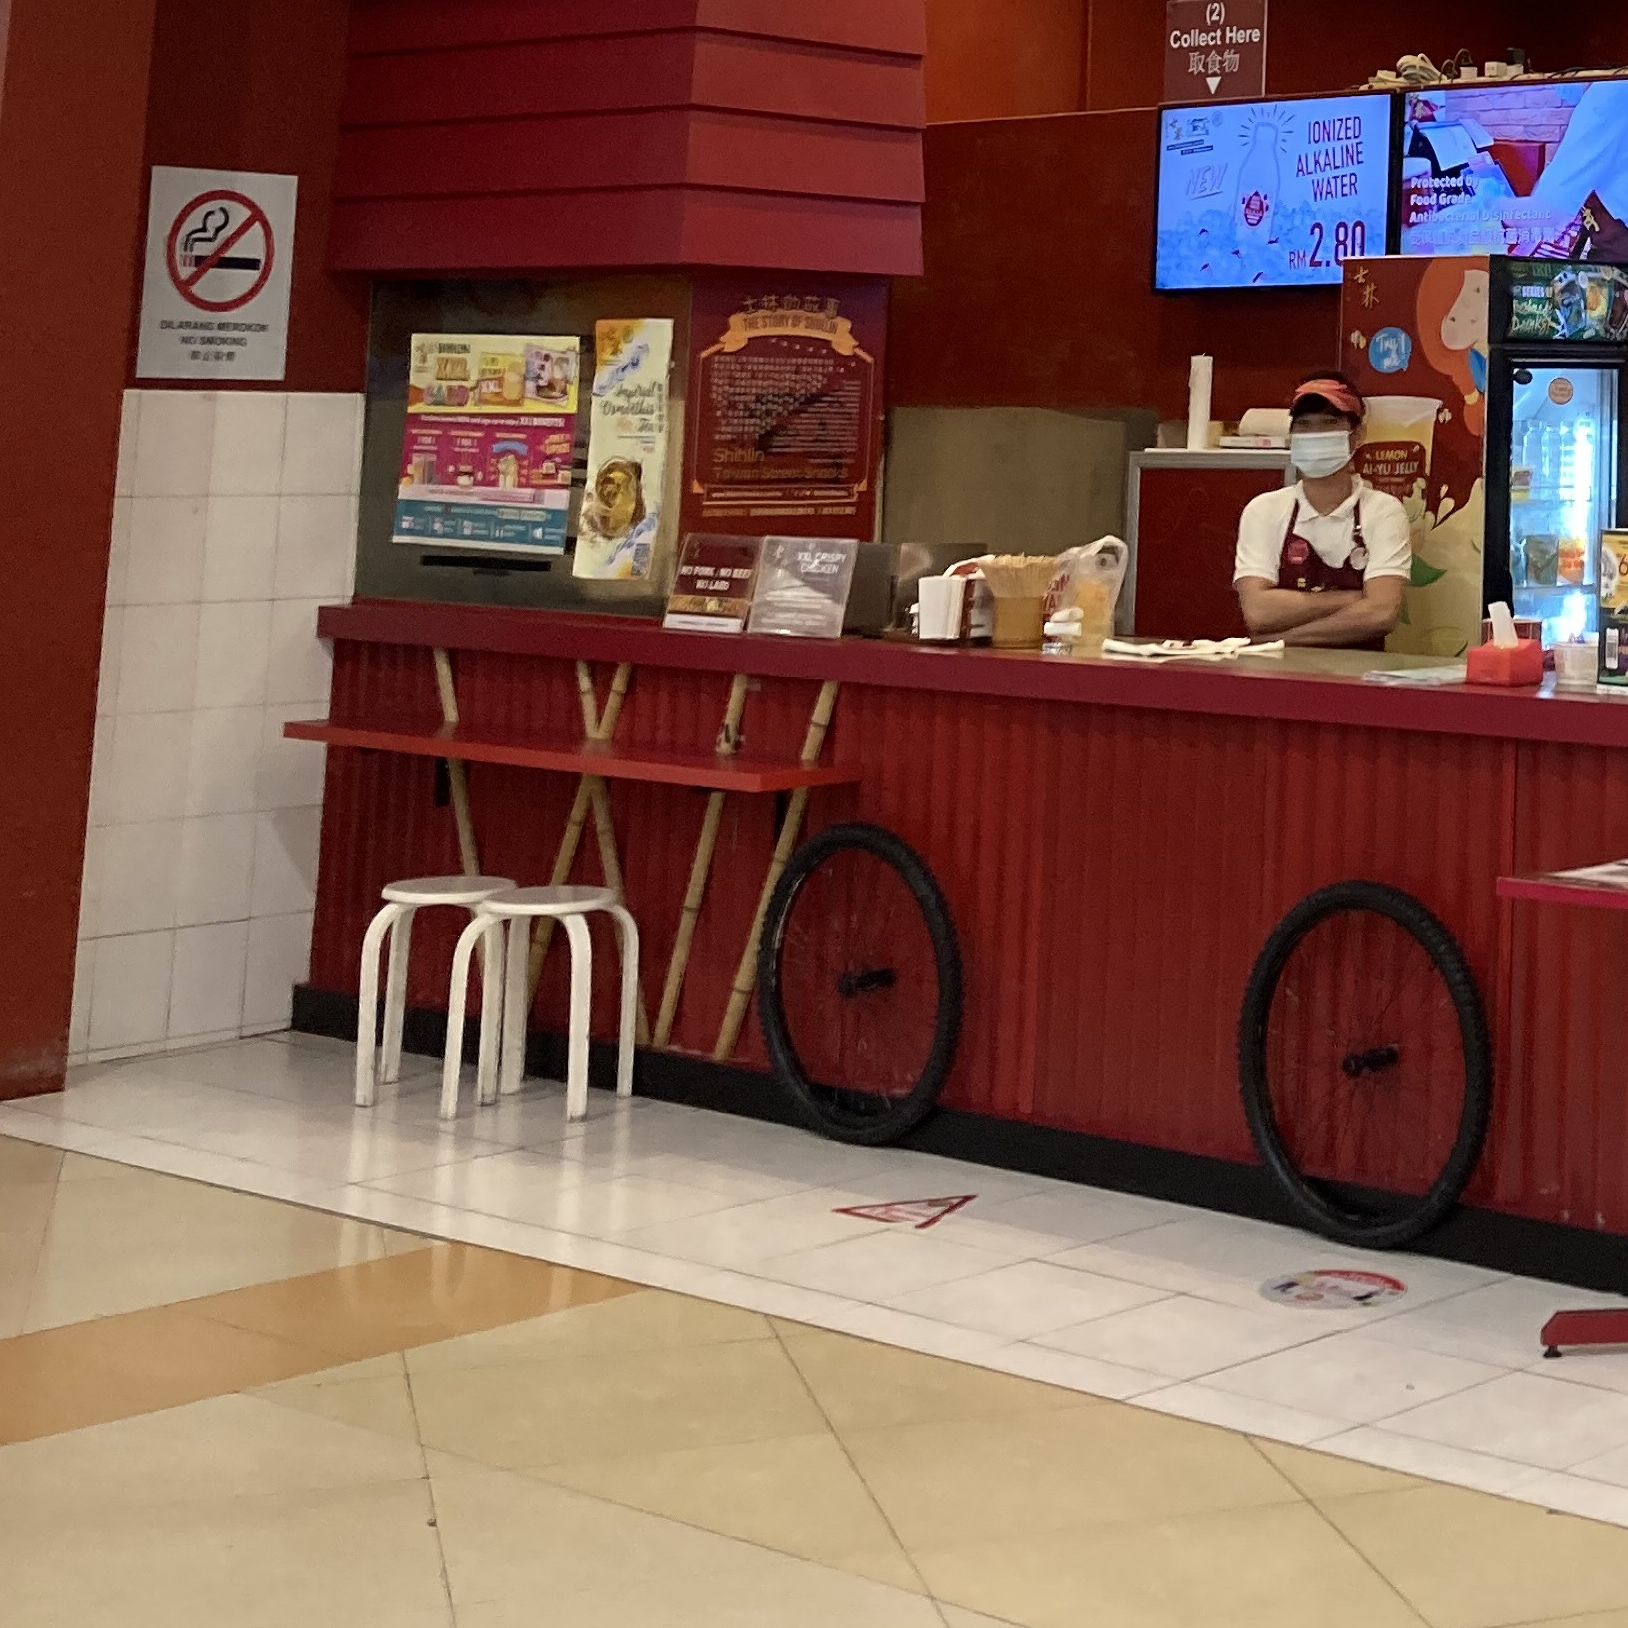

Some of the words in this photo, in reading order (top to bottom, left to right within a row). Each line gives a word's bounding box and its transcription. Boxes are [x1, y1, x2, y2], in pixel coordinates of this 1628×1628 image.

[1206, 2, 1226, 26] (2)
[1169, 28, 1222, 49] Collect
[1225, 26, 1261, 44] Here
[1188, 49, 1240, 76] 取食物
[1307, 116, 1362, 145] IONIZED
[1296, 141, 1364, 177] ALKALINE
[1185, 162, 1228, 197] NEW
[1312, 172, 1358, 202] WATER
[1411, 176, 1463, 189] Protected
[1466, 177, 1479, 191] by
[1410, 193, 1437, 206] Food
[1438, 193, 1471, 205] Grade
[1409, 210, 1479, 223] Antibacterial
[1483, 210, 1551, 221] Disinfectant
[1289, 249, 1306, 270] RM
[1309, 219, 1366, 268] 2.80
[159, 320, 214, 331] DILARANG
[217, 322, 269, 332] MEROKOK
[744, 315, 759, 331] THE
[762, 314, 789, 329] STORY
[791, 315, 802, 328] OF
[180, 336, 197, 345] NO
[199, 337, 247, 347] SMOKING
[713, 447, 765, 463] Shihlin
[1375, 449, 1408, 461] LEMON
[1394, 461, 1419, 475] JELLY
[813, 552, 847, 564] CRISPY
[719, 567, 732, 578] NO
